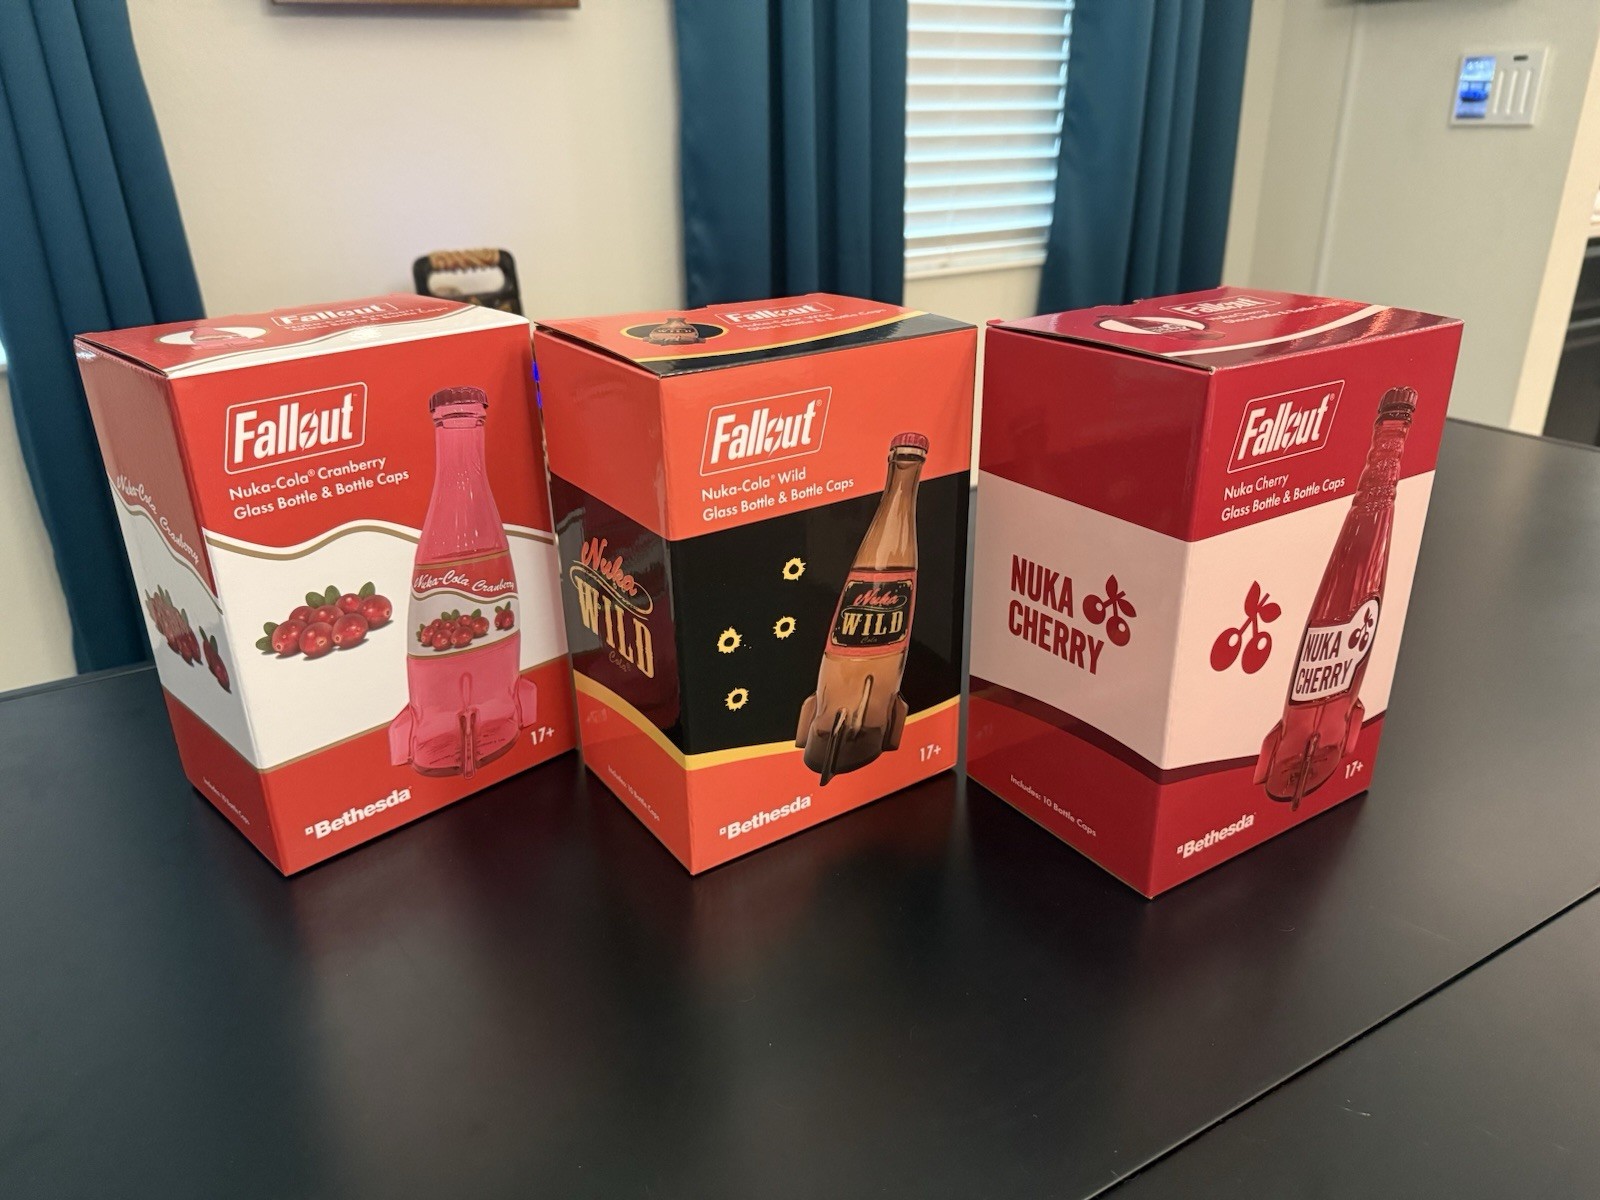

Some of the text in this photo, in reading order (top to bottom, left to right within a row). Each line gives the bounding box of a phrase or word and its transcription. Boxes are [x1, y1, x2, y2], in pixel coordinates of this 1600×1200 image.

[280, 304, 386, 324] Fallout
[725, 304, 821, 323] Fallout
[1171, 297, 1267, 315] Fallout
[234, 392, 353, 464] Fallout
[317, 457, 387, 480] Cranberry
[778, 466, 806, 485] Wild
[233, 469, 410, 520] Glass Bottle & Bottle Caps
[703, 478, 854, 522] Glass Bottle & Bottle Caps
[1221, 478, 1345, 522] Glass Bottle & Bottle Caps
[1223, 474, 1289, 501] Nuka Cherry
[413, 569, 515, 593] Nuka-Cola Cranberry
[581, 537, 638, 597] Nuka
[852, 587, 899, 606] Nuka
[1011, 554, 1074, 619] NUKA
[574, 575, 655, 679] WILD
[841, 610, 904, 636] WILD
[1009, 599, 1105, 675] CHERRY
[1303, 631, 1343, 662] NUKA
[1295, 658, 1353, 694] CHERRY
[530, 726, 555, 745] 17+
[919, 744, 942, 762] 17+
[1345, 760, 1364, 779] 17+
[314, 786, 411, 839] Bethesda
[727, 795, 812, 840] Bethesda
[1043, 796, 1052, 807] 10
[1053, 803, 1075, 822] Bottle
[1076, 818, 1096, 837] Caps
[1182, 813, 1255, 859] Bethesda
